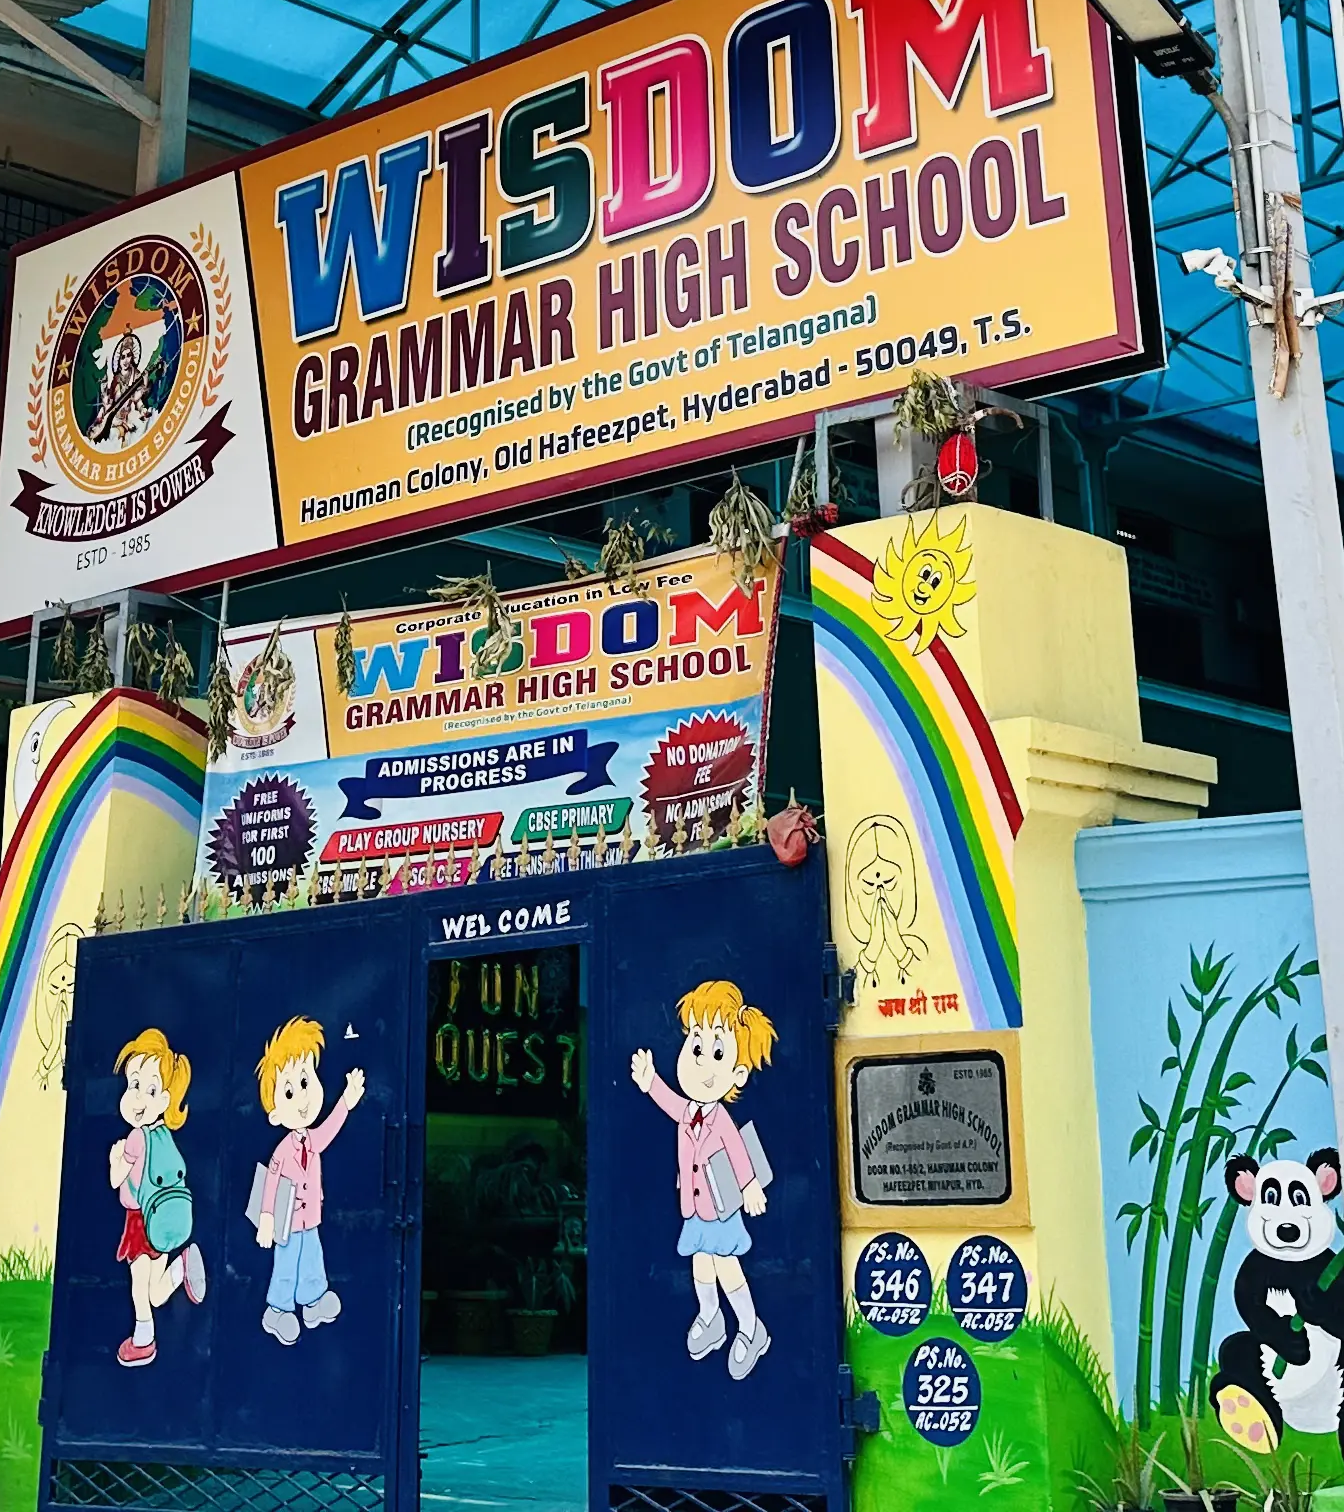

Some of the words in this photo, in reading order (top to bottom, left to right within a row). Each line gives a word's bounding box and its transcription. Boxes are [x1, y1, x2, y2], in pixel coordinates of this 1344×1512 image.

[65, 246, 194, 336] WISDOM
[294, 281, 577, 440] GRAMMAR
[598, 220, 749, 351] HIGH
[774, 128, 1067, 298] SCHOOL
[407, 387, 543, 451] (Recognised
[549, 384, 576, 412] by
[582, 373, 622, 400] the
[628, 349, 688, 389] Govt
[694, 343, 722, 370] of
[726, 295, 877, 364] Telangana)
[54, 389, 101, 481] GRAMMAR
[104, 448, 152, 482] HIGH
[152, 341, 202, 446] SCHOOL
[300, 477, 401, 524] Hanuman
[406, 457, 489, 494] Colony,
[494, 435, 532, 472] Old
[539, 407, 677, 463] Hafeezpet,
[683, 360, 831, 426] Hyderabad
[855, 331, 969, 376] 50049,
[978, 309, 1031, 346] T.S.
[32, 498, 128, 537] KNOWLEDGE
[130, 488, 147, 524] IS
[149, 454, 206, 515] POWER
[76, 546, 108, 571] ESTD
[120, 533, 151, 559] 1985
[395, 609, 482, 636] Corporate
[585, 589, 603, 601] in
[655, 572, 694, 588] Fee
[345, 681, 506, 731] GRAMMAR
[517, 665, 597, 705] HIGH
[611, 644, 752, 688] SCHOOL
[443, 715, 502, 731] (Recognised
[504, 712, 516, 722] by
[517, 710, 534, 719] the
[536, 706, 560, 718] Govt
[561, 703, 573, 714] of
[575, 695, 633, 711] Telangana)
[377, 748, 503, 779] ADMISSIONS
[505, 740, 547, 762] ARE
[552, 734, 575, 755] IN
[666, 746, 686, 767] NO
[689, 736, 742, 765] DONATION
[420, 764, 528, 794] PROGRESS
[693, 764, 713, 786] FEE
[253, 790, 279, 807] FREE
[240, 806, 292, 827] UNIFORMS
[527, 808, 559, 833] CBSE
[561, 803, 615, 827] PRIMARY
[241, 829, 259, 845] FOR
[260, 825, 290, 843] FIRST
[338, 831, 373, 853] PLAY
[375, 825, 421, 849] GROUP
[422, 817, 486, 844] NURSERY
[250, 845, 276, 867] 100
[498, 899, 571, 933] COME
[931, 992, 959, 1016] राम
[435, 1023, 577, 1089] QUEST
[861, 1111, 897, 1160] WISDOM
[896, 1099, 941, 1125] GRAMMAR
[941, 1099, 966, 1125] HIGH
[967, 1110, 1003, 1158] SCHOOL
[926, 1140, 935, 1153] by
[867, 1164, 888, 1176] DOOR
[927, 1162, 966, 1175] HANUMAN
[967, 1161, 999, 1173] COLONY
[870, 1268, 923, 1302] 346
[960, 1271, 1015, 1304] 347
[916, 1374, 969, 1405] 325
